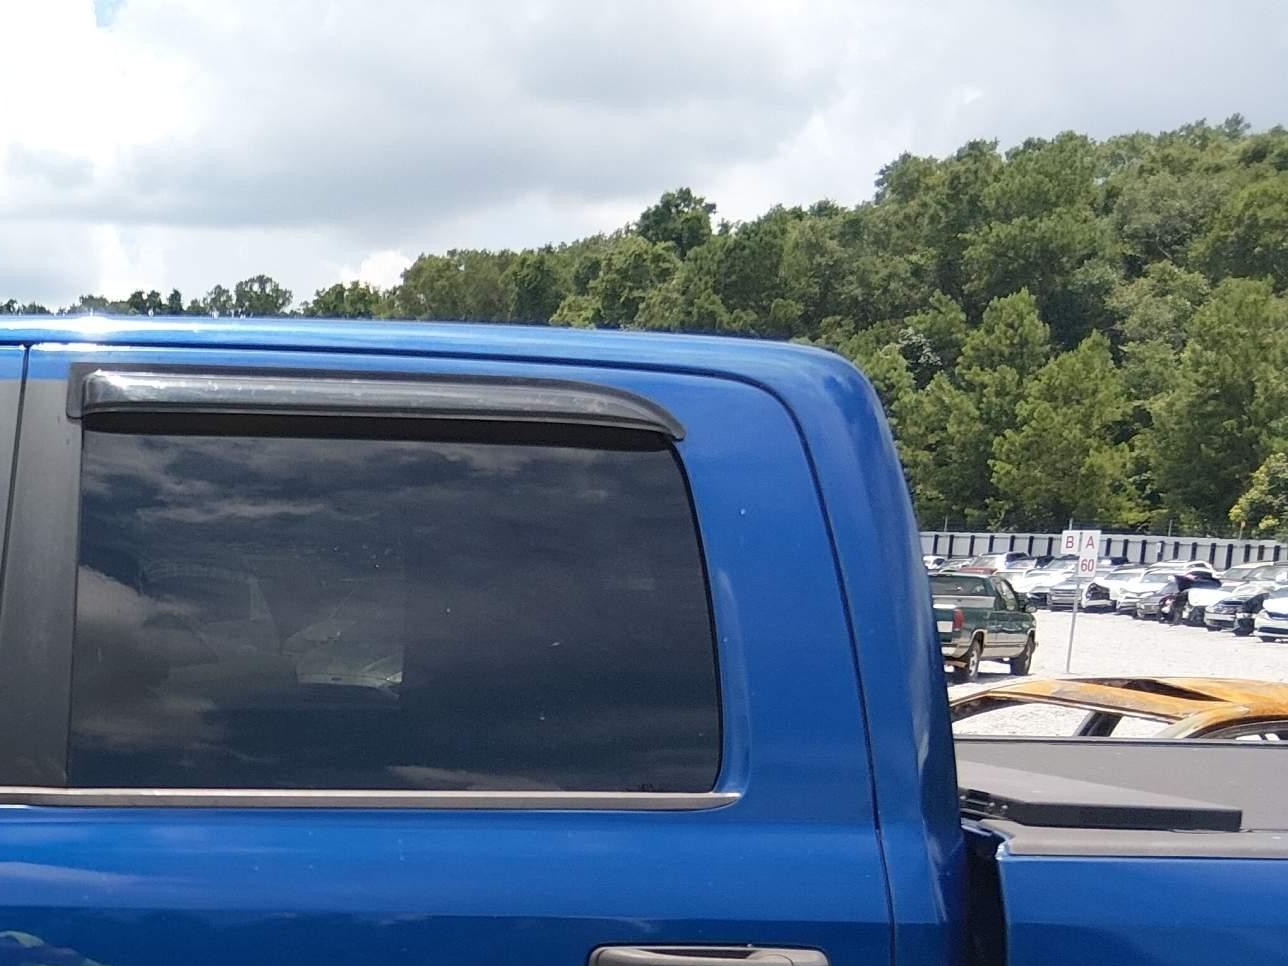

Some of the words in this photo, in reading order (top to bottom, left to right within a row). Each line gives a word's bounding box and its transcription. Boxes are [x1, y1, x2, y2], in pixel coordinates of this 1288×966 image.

[1065, 535, 1075, 549] B
[1085, 535, 1095, 549] A
[1080, 558, 1095, 572] 60
